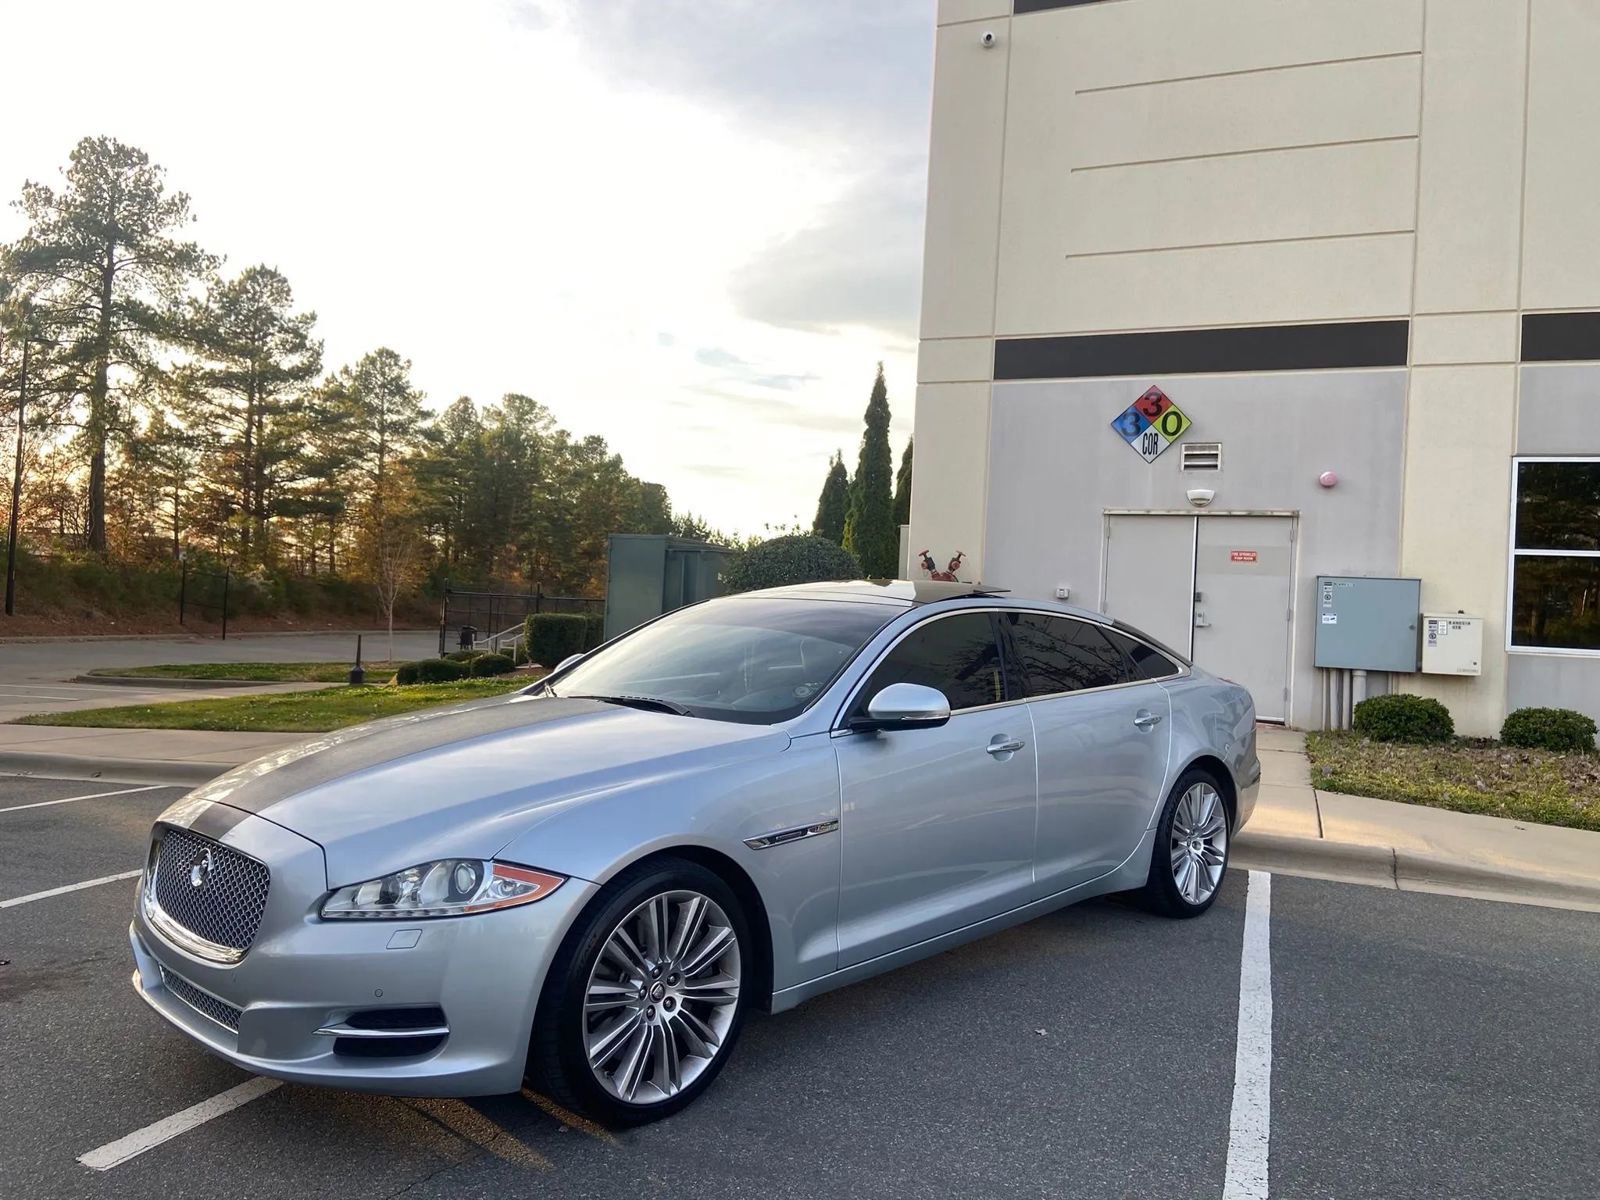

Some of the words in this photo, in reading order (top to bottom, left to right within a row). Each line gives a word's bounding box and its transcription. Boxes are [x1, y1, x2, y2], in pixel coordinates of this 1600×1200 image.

[1143, 392, 1162, 417] 3
[1121, 412, 1141, 437] 3
[1161, 411, 1183, 437] 0
[1142, 432, 1159, 455] COR
